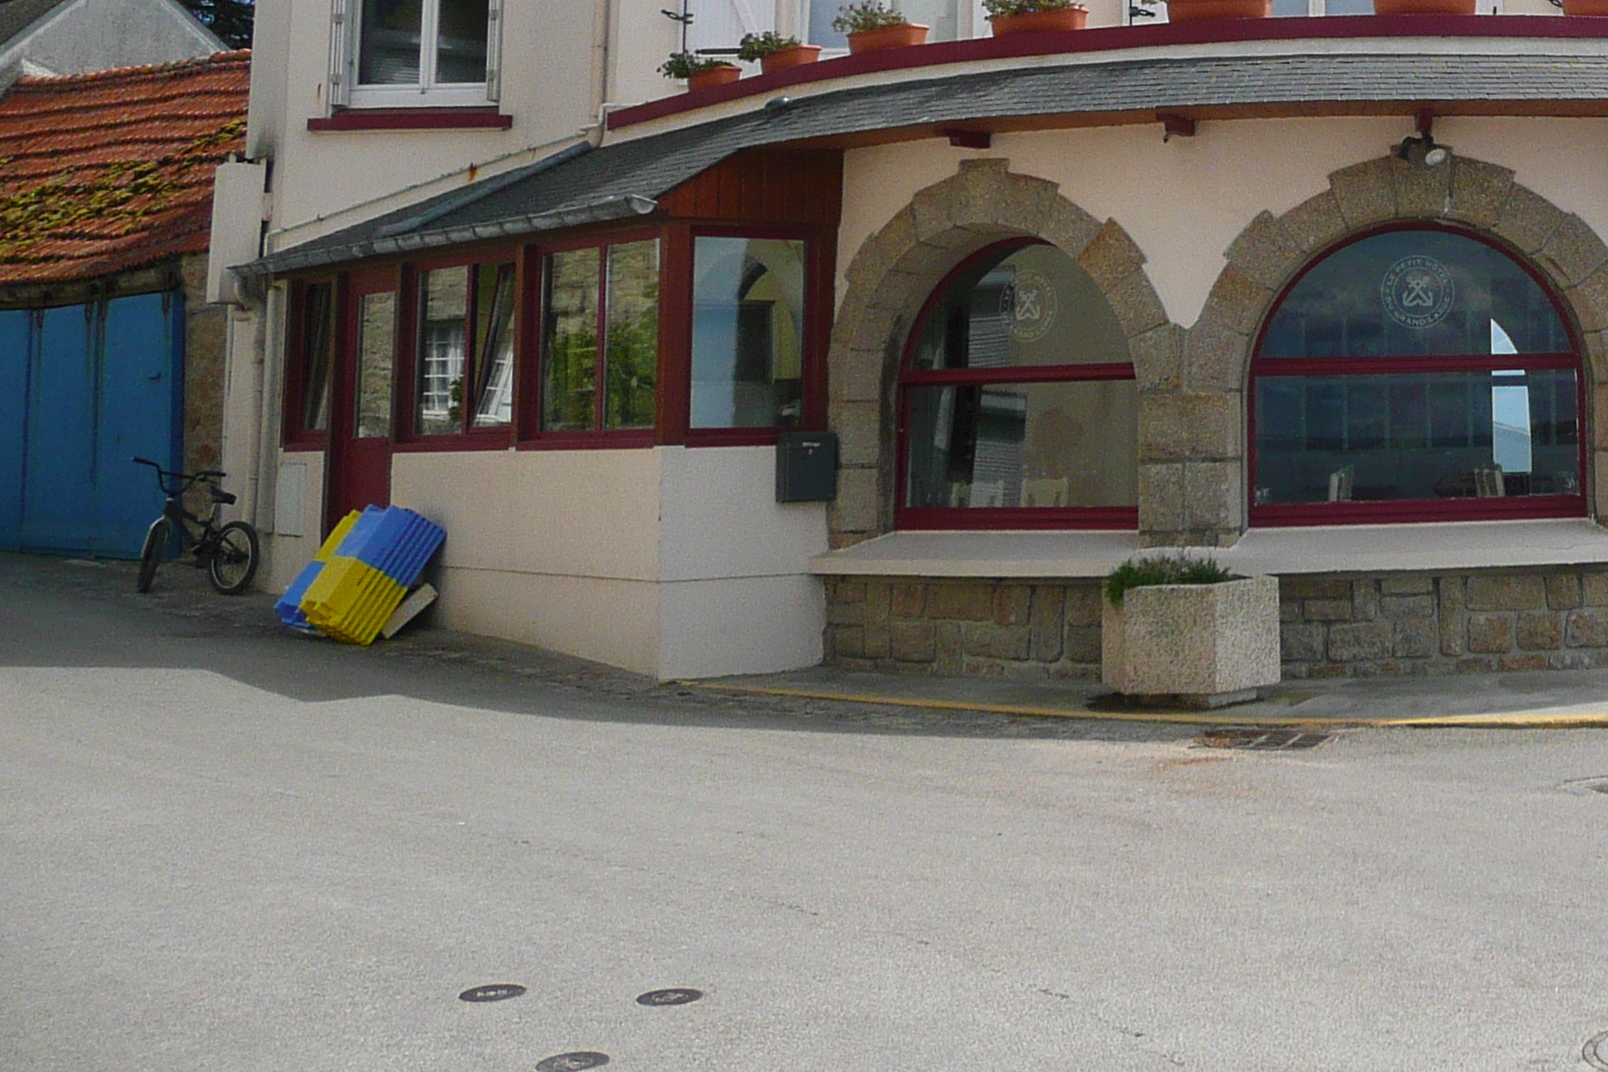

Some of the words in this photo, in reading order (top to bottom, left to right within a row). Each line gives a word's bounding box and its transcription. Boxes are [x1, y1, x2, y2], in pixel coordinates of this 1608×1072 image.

[1387, 273, 1395, 286] LE
[1396, 259, 1420, 273] PETIT
[1385, 297, 1395, 310] DU
[1394, 311, 1426, 325] GRAND
